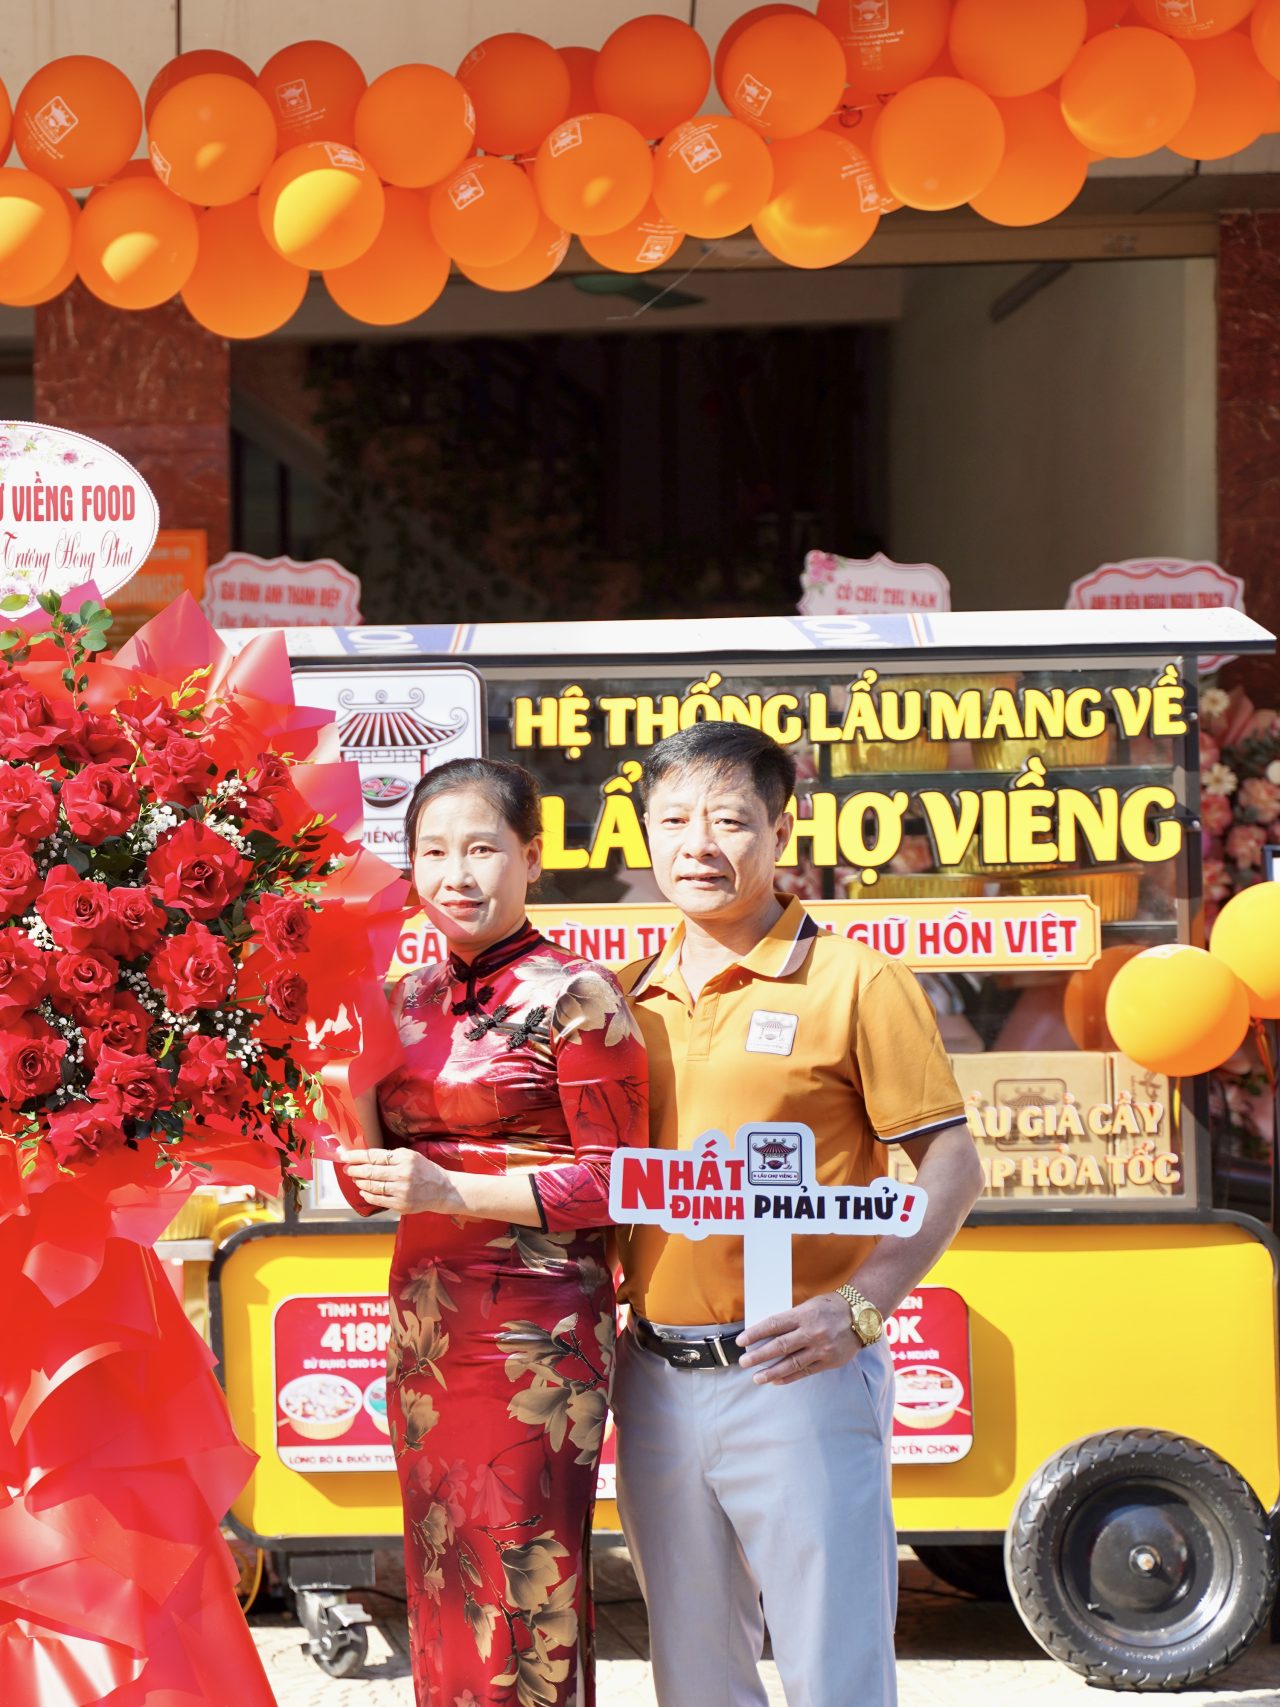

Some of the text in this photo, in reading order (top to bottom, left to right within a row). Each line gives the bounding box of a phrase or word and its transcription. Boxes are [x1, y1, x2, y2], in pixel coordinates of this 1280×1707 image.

[12, 471, 73, 522] VIỀNG
[81, 485, 135, 522] FOOD
[55, 528, 95, 582] Hồng
[99, 529, 133, 570] Phát
[515, 684, 592, 760] HỆ
[808, 668, 921, 743] LẨU
[929, 686, 1107, 741] MANG
[1110, 662, 1188, 737] VỀ
[540, 754, 1183, 886] LẨ HỢ VIỀNG
[396, 921, 442, 965] GẮ
[549, 921, 625, 960] TÌNH
[847, 916, 908, 956] GIỮ
[919, 910, 992, 955] HỒN
[1004, 912, 1077, 958] VIỆT
[964, 1090, 1012, 1138] ẨU
[1017, 1092, 1086, 1138] GIẢ
[621, 1138, 745, 1211] NHẤT
[669, 1194, 745, 1227] ĐỊNH
[754, 1185, 826, 1221] PHẢI
[347, 1358, 369, 1370] CHO
